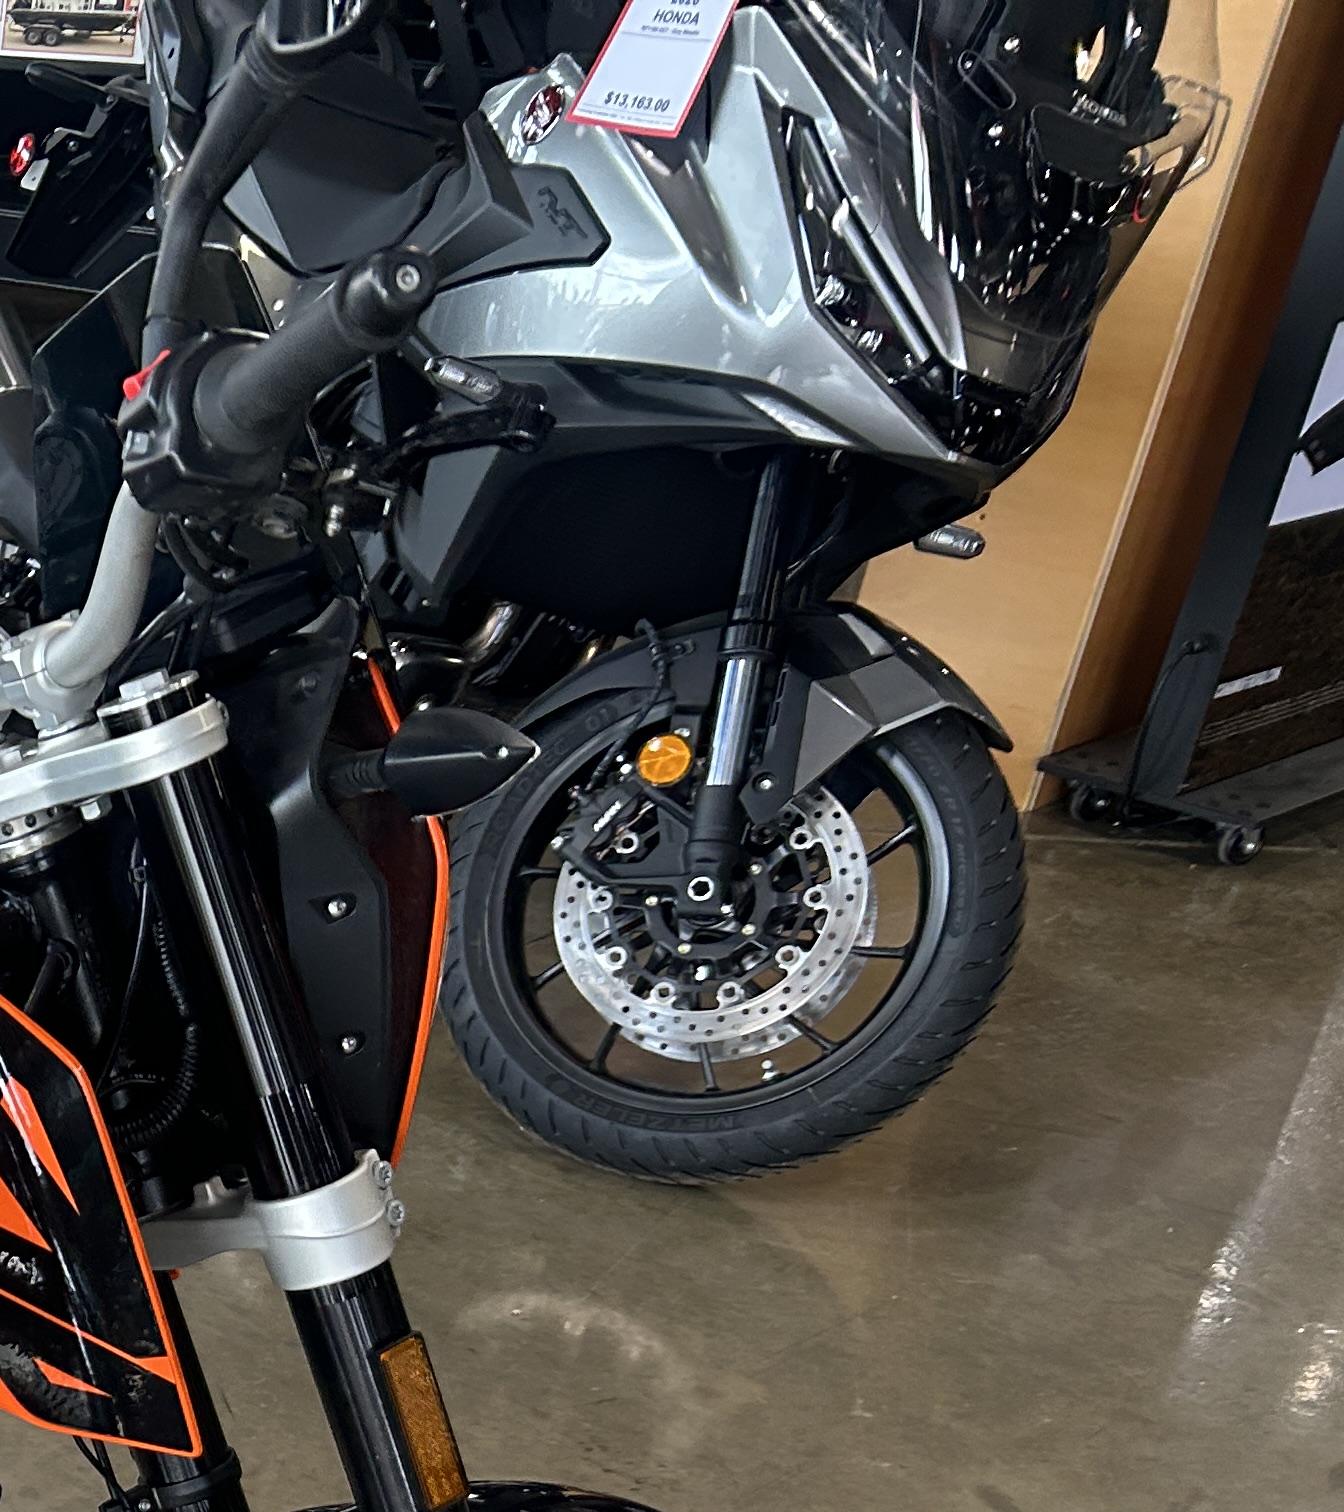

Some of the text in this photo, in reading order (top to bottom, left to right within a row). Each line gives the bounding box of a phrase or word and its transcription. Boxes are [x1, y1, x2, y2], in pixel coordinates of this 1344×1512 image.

[652, 9, 700, 25] HONDA
[604, 91, 670, 112] $13,163.00
[571, 1093, 735, 1131] METZELER
